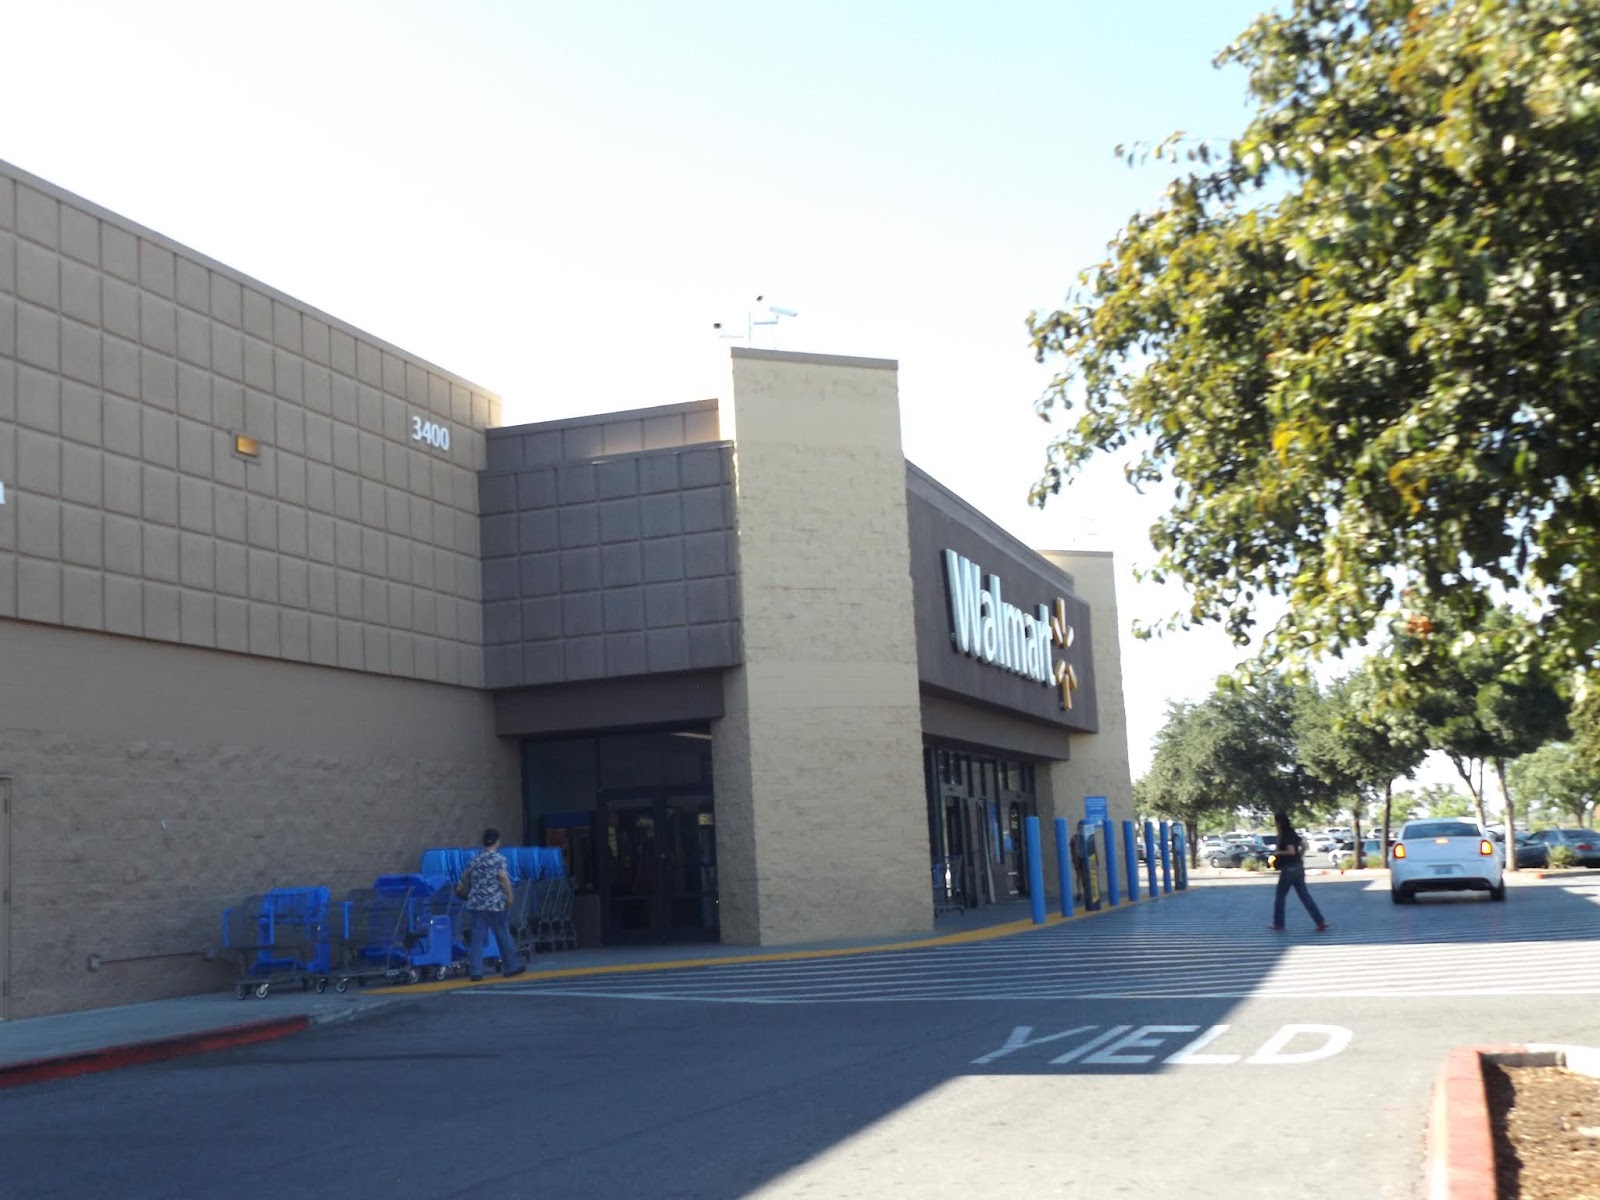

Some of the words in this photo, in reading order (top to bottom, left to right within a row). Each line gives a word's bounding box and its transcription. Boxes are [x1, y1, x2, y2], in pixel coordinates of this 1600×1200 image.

[411, 415, 450, 451] 3400
[945, 548, 1057, 687] Walmart
[968, 1024, 1353, 1065] YIELD
